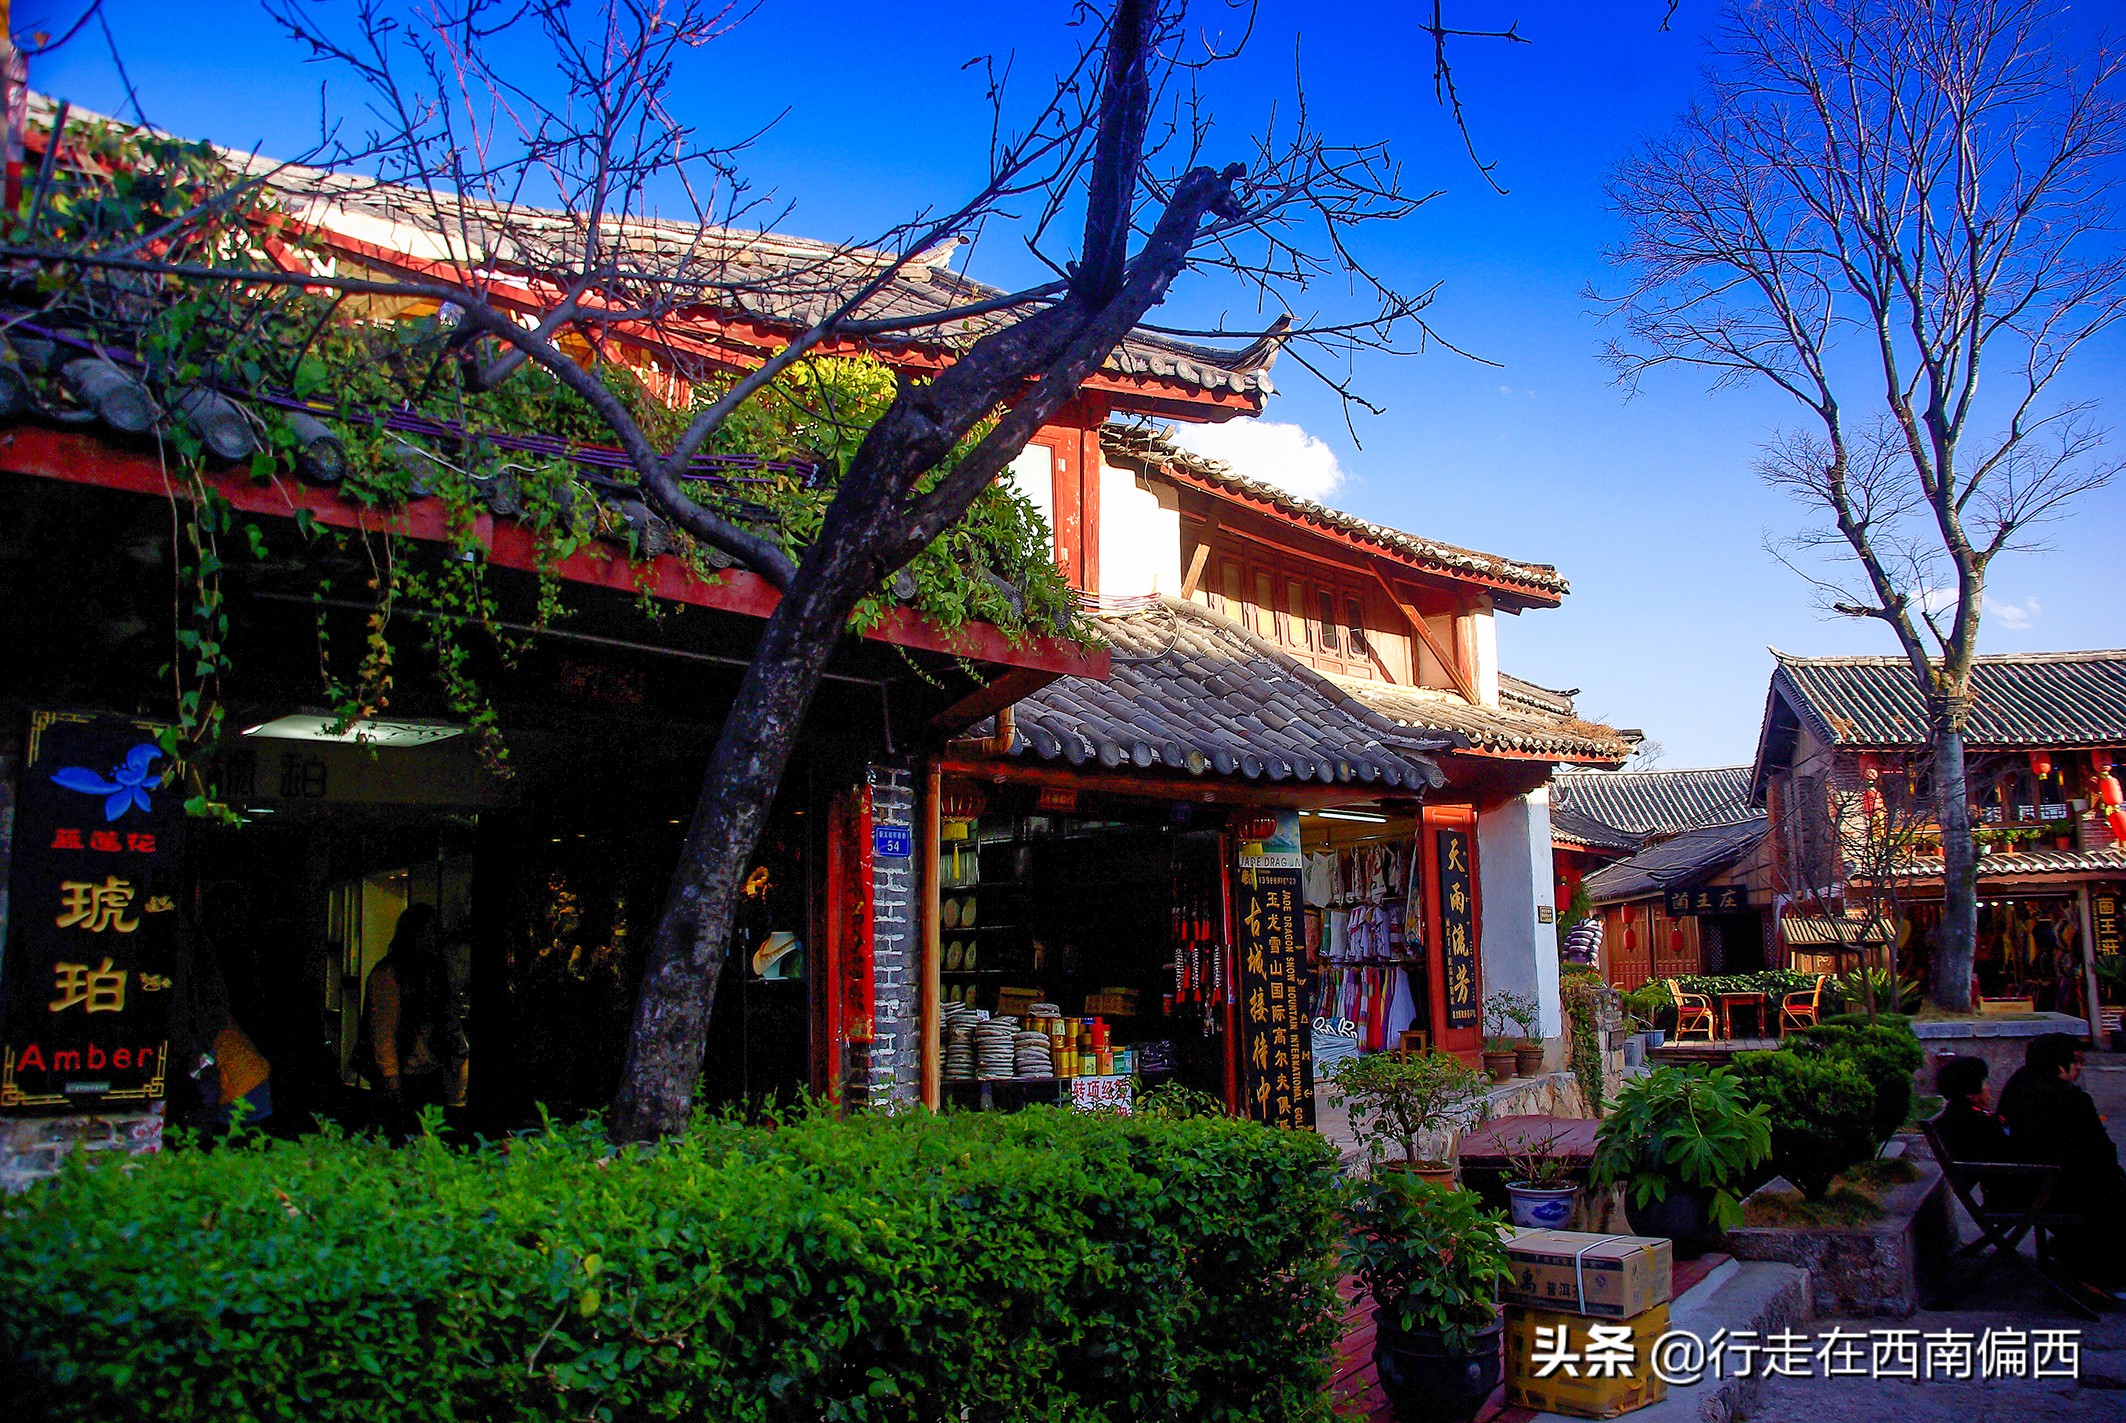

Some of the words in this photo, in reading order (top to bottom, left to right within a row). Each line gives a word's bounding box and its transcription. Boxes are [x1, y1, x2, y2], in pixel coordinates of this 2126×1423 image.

[887, 840, 900, 852] 54
[1264, 857, 1300, 867] DRAGN
[1282, 890, 1292, 912] JADE
[1283, 916, 1295, 953] DRAGON
[1448, 838, 1471, 1005] 天雨流芳
[50, 875, 140, 1013] 琥珀
[1285, 956, 1296, 983] SNOW
[1244, 897, 1271, 1120] 古城接待中
[1287, 986, 1299, 1031] MOUNTAIN
[16, 1042, 153, 1073] Amber
[1290, 1034, 1303, 1103] INTERNATIONAL
